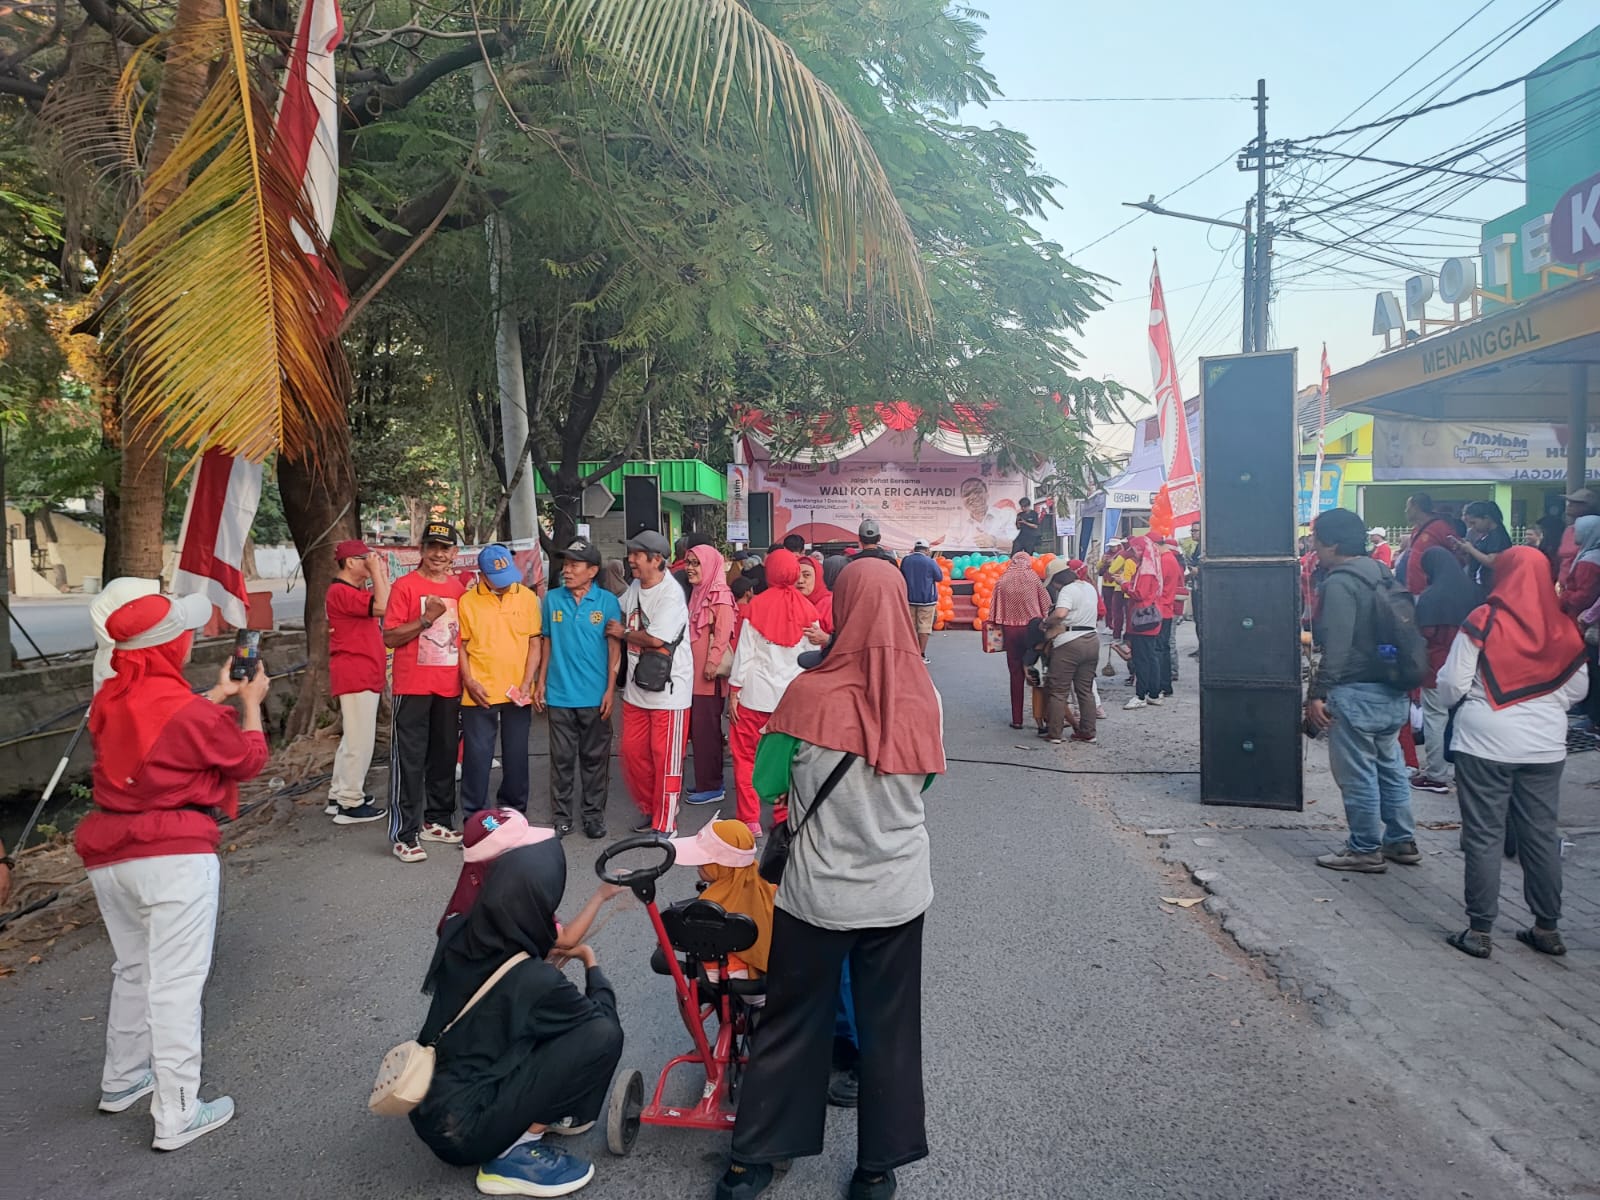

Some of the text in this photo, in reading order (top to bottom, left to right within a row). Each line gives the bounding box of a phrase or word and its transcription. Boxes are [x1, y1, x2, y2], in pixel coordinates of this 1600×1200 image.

[1422, 317, 1541, 375] MENANGGAL
[850, 477, 921, 485] Jalan Sehat Bersama
[819, 486, 956, 497] WALI KOTA ERI CAHYADI
[1124, 493, 1139, 503] BRI
